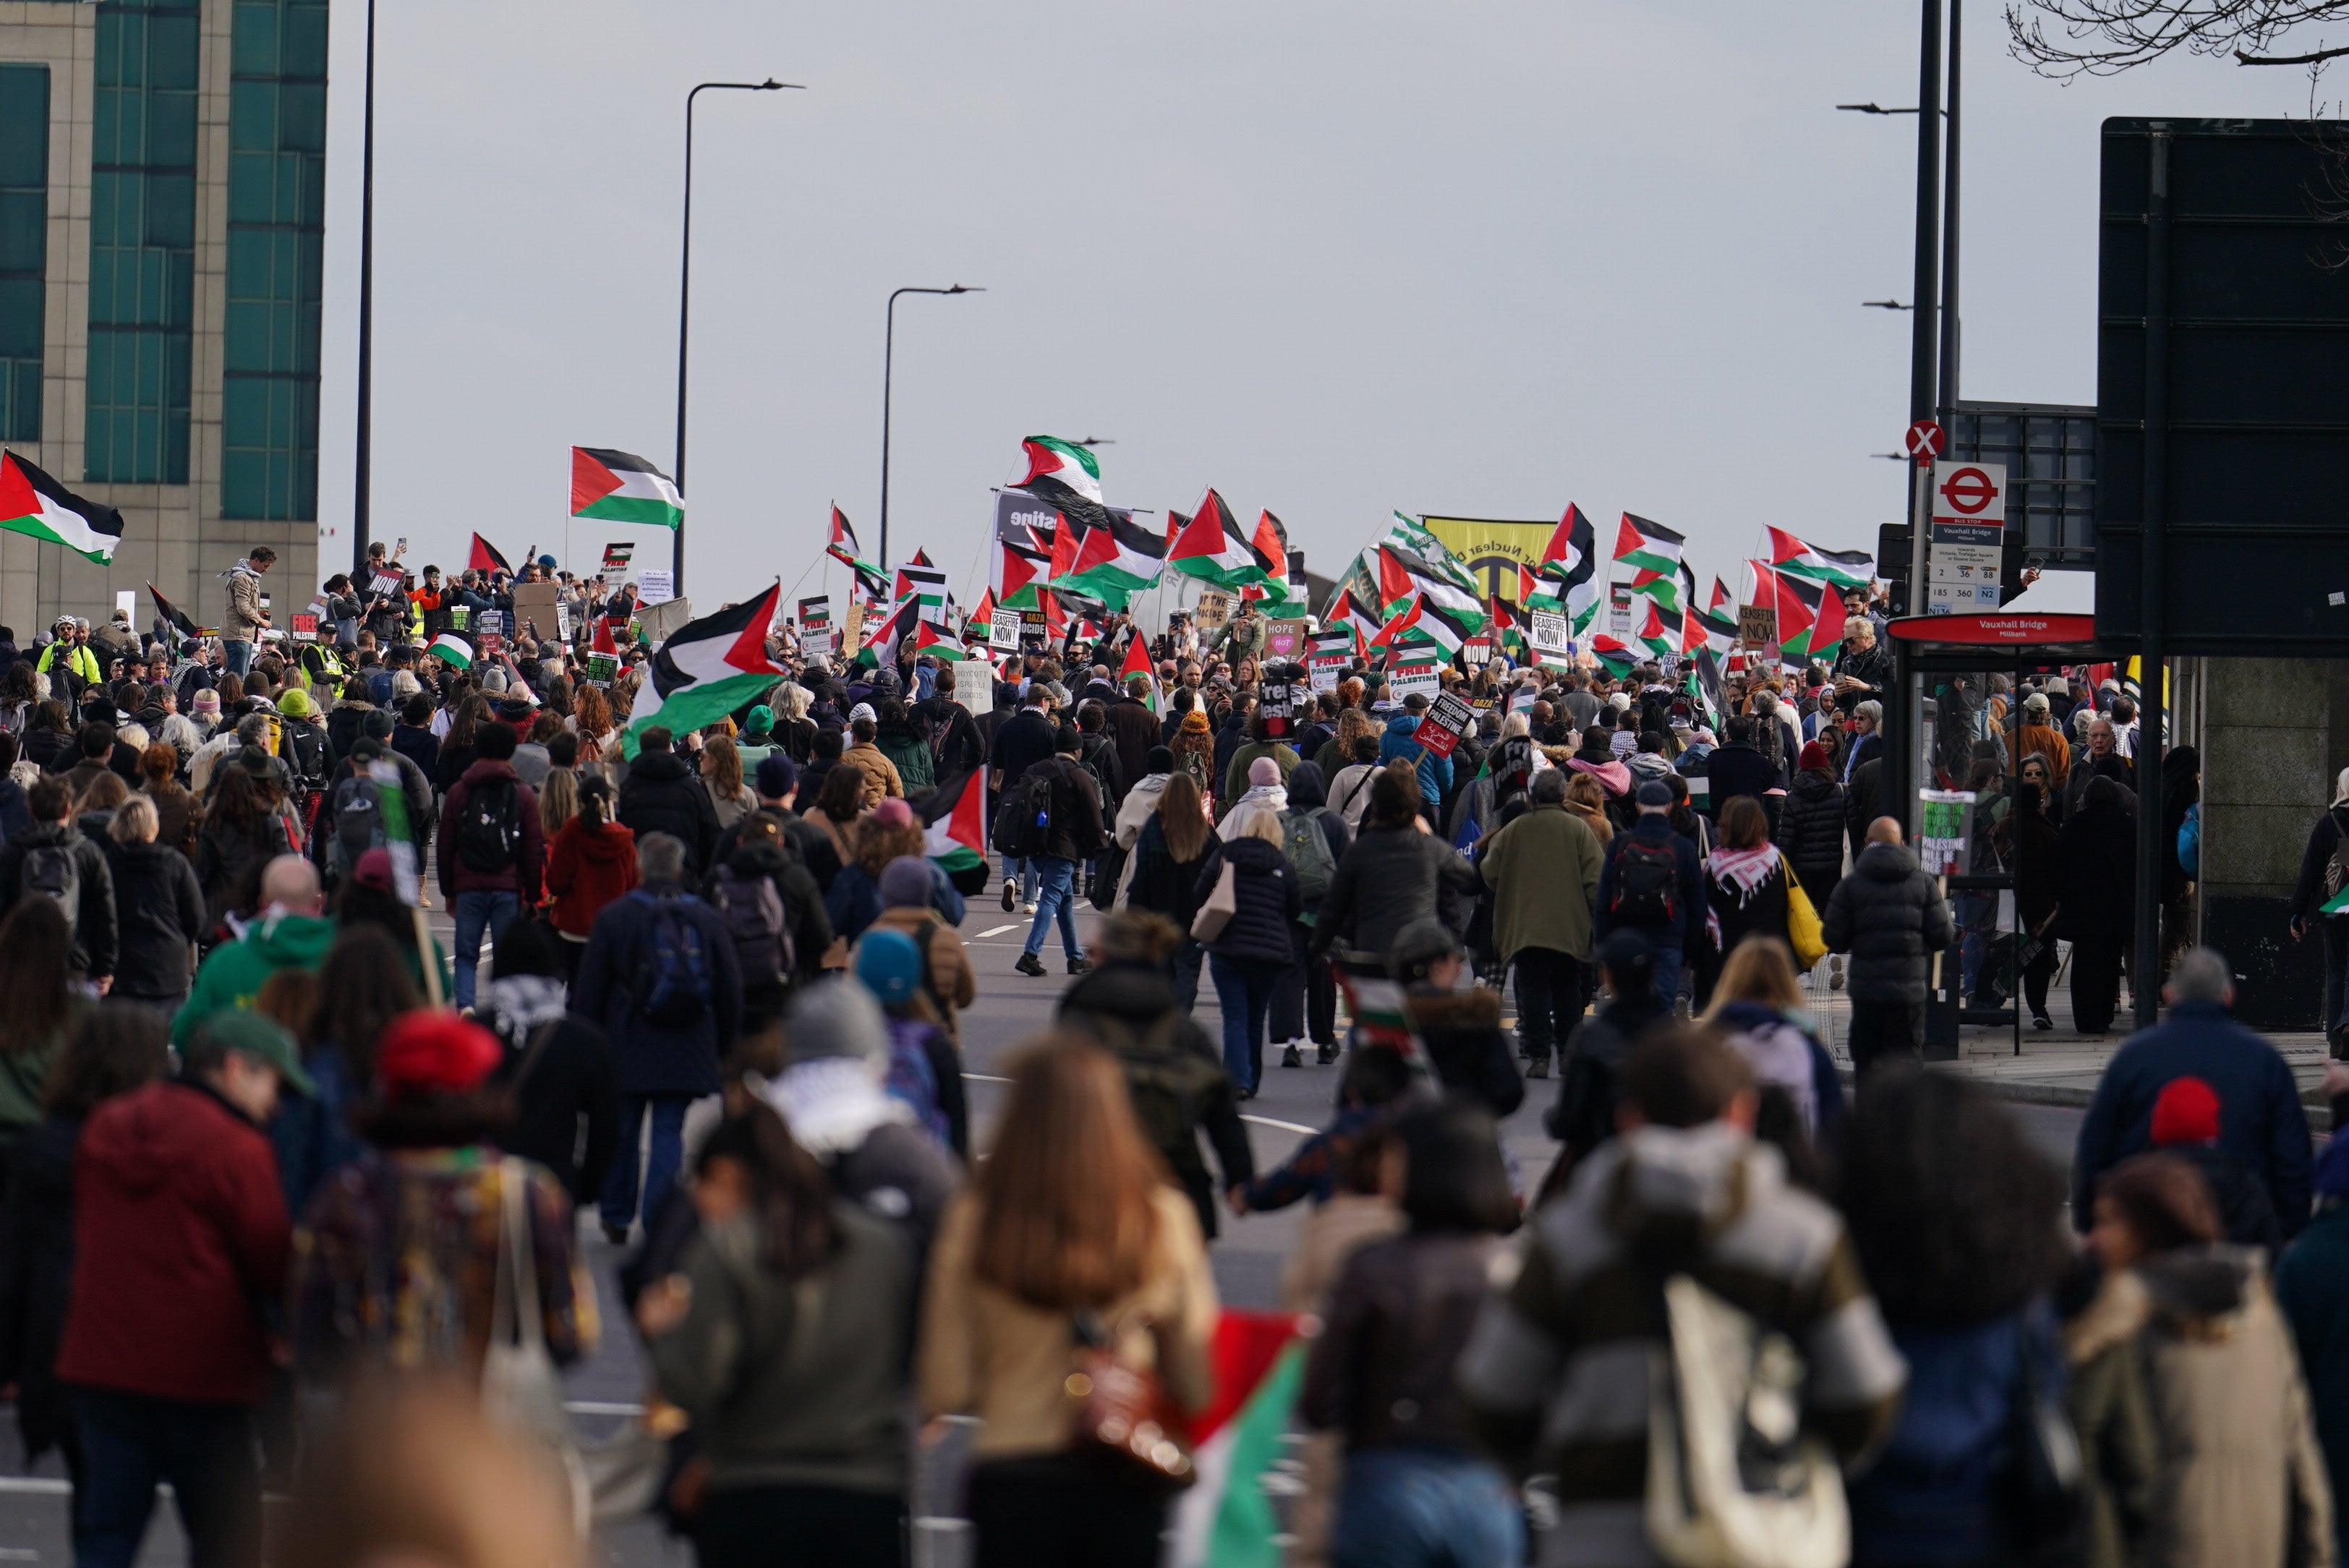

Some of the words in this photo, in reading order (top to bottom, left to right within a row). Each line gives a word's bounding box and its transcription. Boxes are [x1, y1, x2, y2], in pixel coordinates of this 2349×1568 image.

[1911, 427, 1937, 455] X
[369, 575, 398, 595] NOW
[1211, 595, 1227, 608] THE
[292, 615, 317, 631] FREE
[992, 614, 1018, 629] CEASEFIRE
[1027, 613, 1045, 622] GAZA
[1534, 616, 1565, 632] CEASEFIRE
[805, 619, 827, 631] FREE
[1020, 623, 1045, 634] OCIDE
[1268, 624, 1295, 634] HOPE
[1979, 620, 2018, 629] Vauxhall
[2020, 620, 2047, 630] Bridge
[293, 631, 317, 640] PALESTINE
[801, 629, 830, 637] PALESTINE
[1538, 629, 1562, 647] NOW!
[1747, 623, 1773, 642] NOW
[1315, 654, 1346, 667] FREE
[1464, 645, 1490, 663] NOW
[956, 670, 988, 678] BOYCOTT
[1396, 664, 1432, 678] FREE
[1665, 667, 1676, 678] NO
[1391, 675, 1437, 686] PALESTINE
[1436, 697, 1469, 723] FREEDOM
[1472, 699, 1493, 708] GAZA
[1428, 709, 1463, 736] PALESTINE
[1428, 723, 1450, 741] الحرية
[1419, 732, 1449, 751] لفلسطين
[1953, 803, 1966, 814] THE
[1922, 836, 1966, 851] PALESTINE
[1922, 848, 1943, 861] WILL
[1921, 860, 1943, 874] FREE
